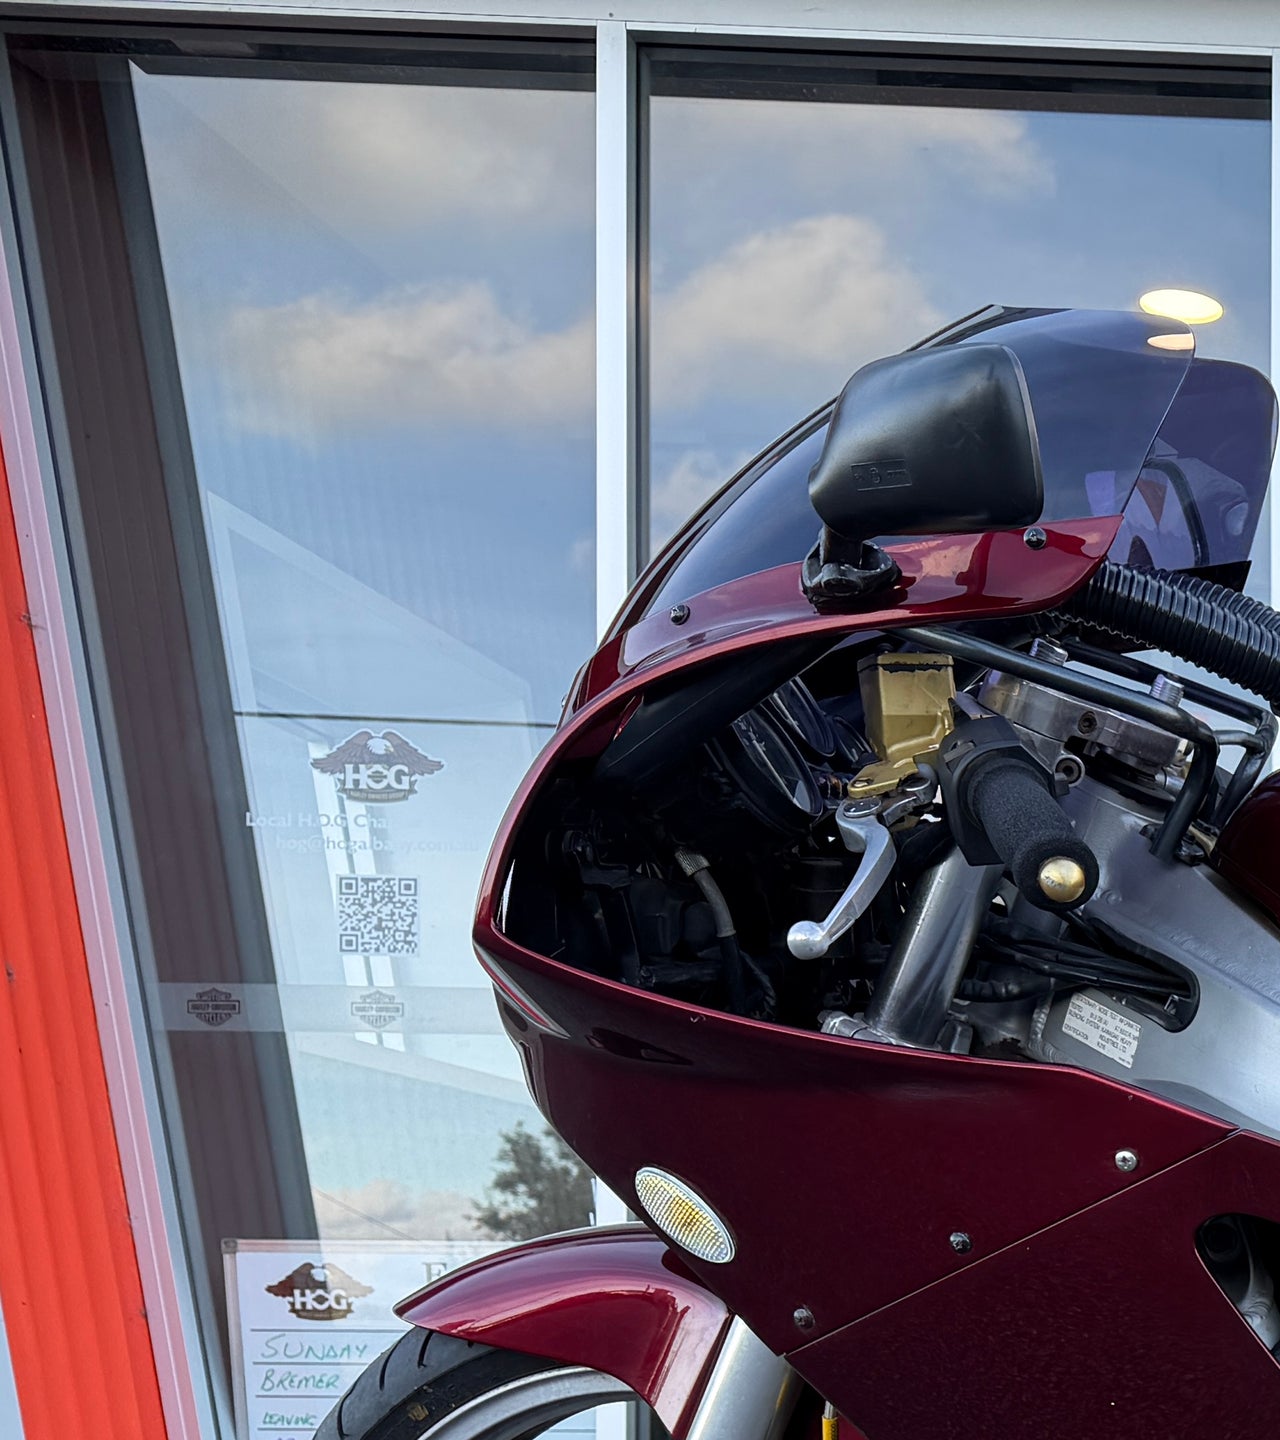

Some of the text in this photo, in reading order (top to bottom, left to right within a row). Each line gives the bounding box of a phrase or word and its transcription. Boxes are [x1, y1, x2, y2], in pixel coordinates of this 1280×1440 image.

[344, 763, 411, 790] HOG
[245, 811, 291, 828] Local
[293, 1289, 347, 1311] HOG
[261, 1333, 368, 1361] SUNDAY
[261, 1368, 340, 1392] BREMER
